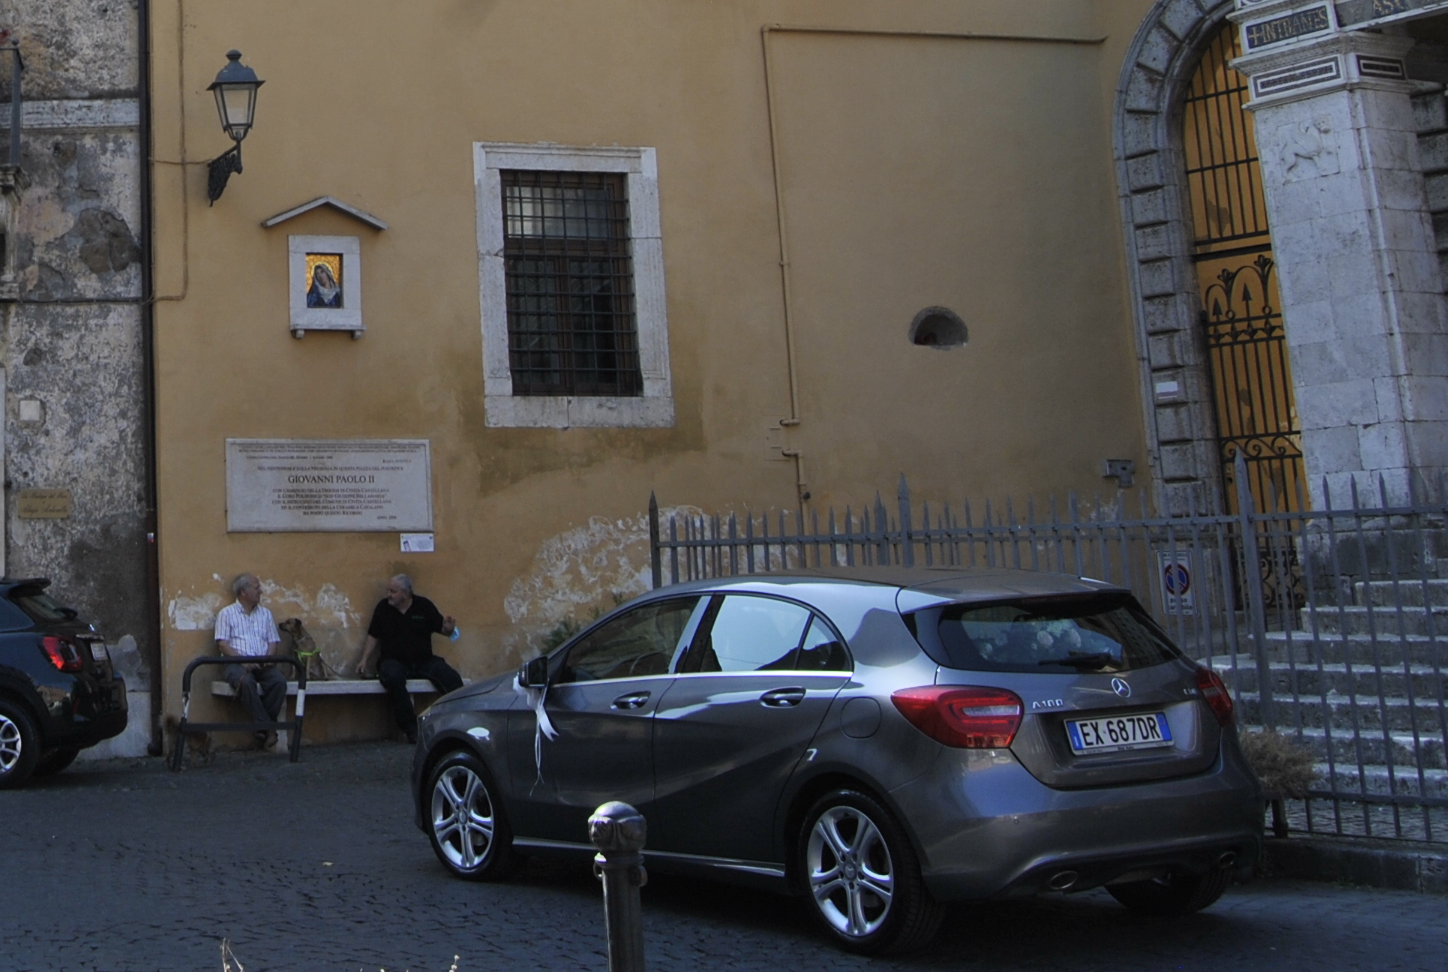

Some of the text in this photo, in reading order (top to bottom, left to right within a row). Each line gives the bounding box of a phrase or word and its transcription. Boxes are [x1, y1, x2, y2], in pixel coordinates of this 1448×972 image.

[287, 475, 375, 483] GIOVANNI PAOLO II
[1079, 722, 1105, 747] EX
[1106, 714, 1161, 744] 687DR
